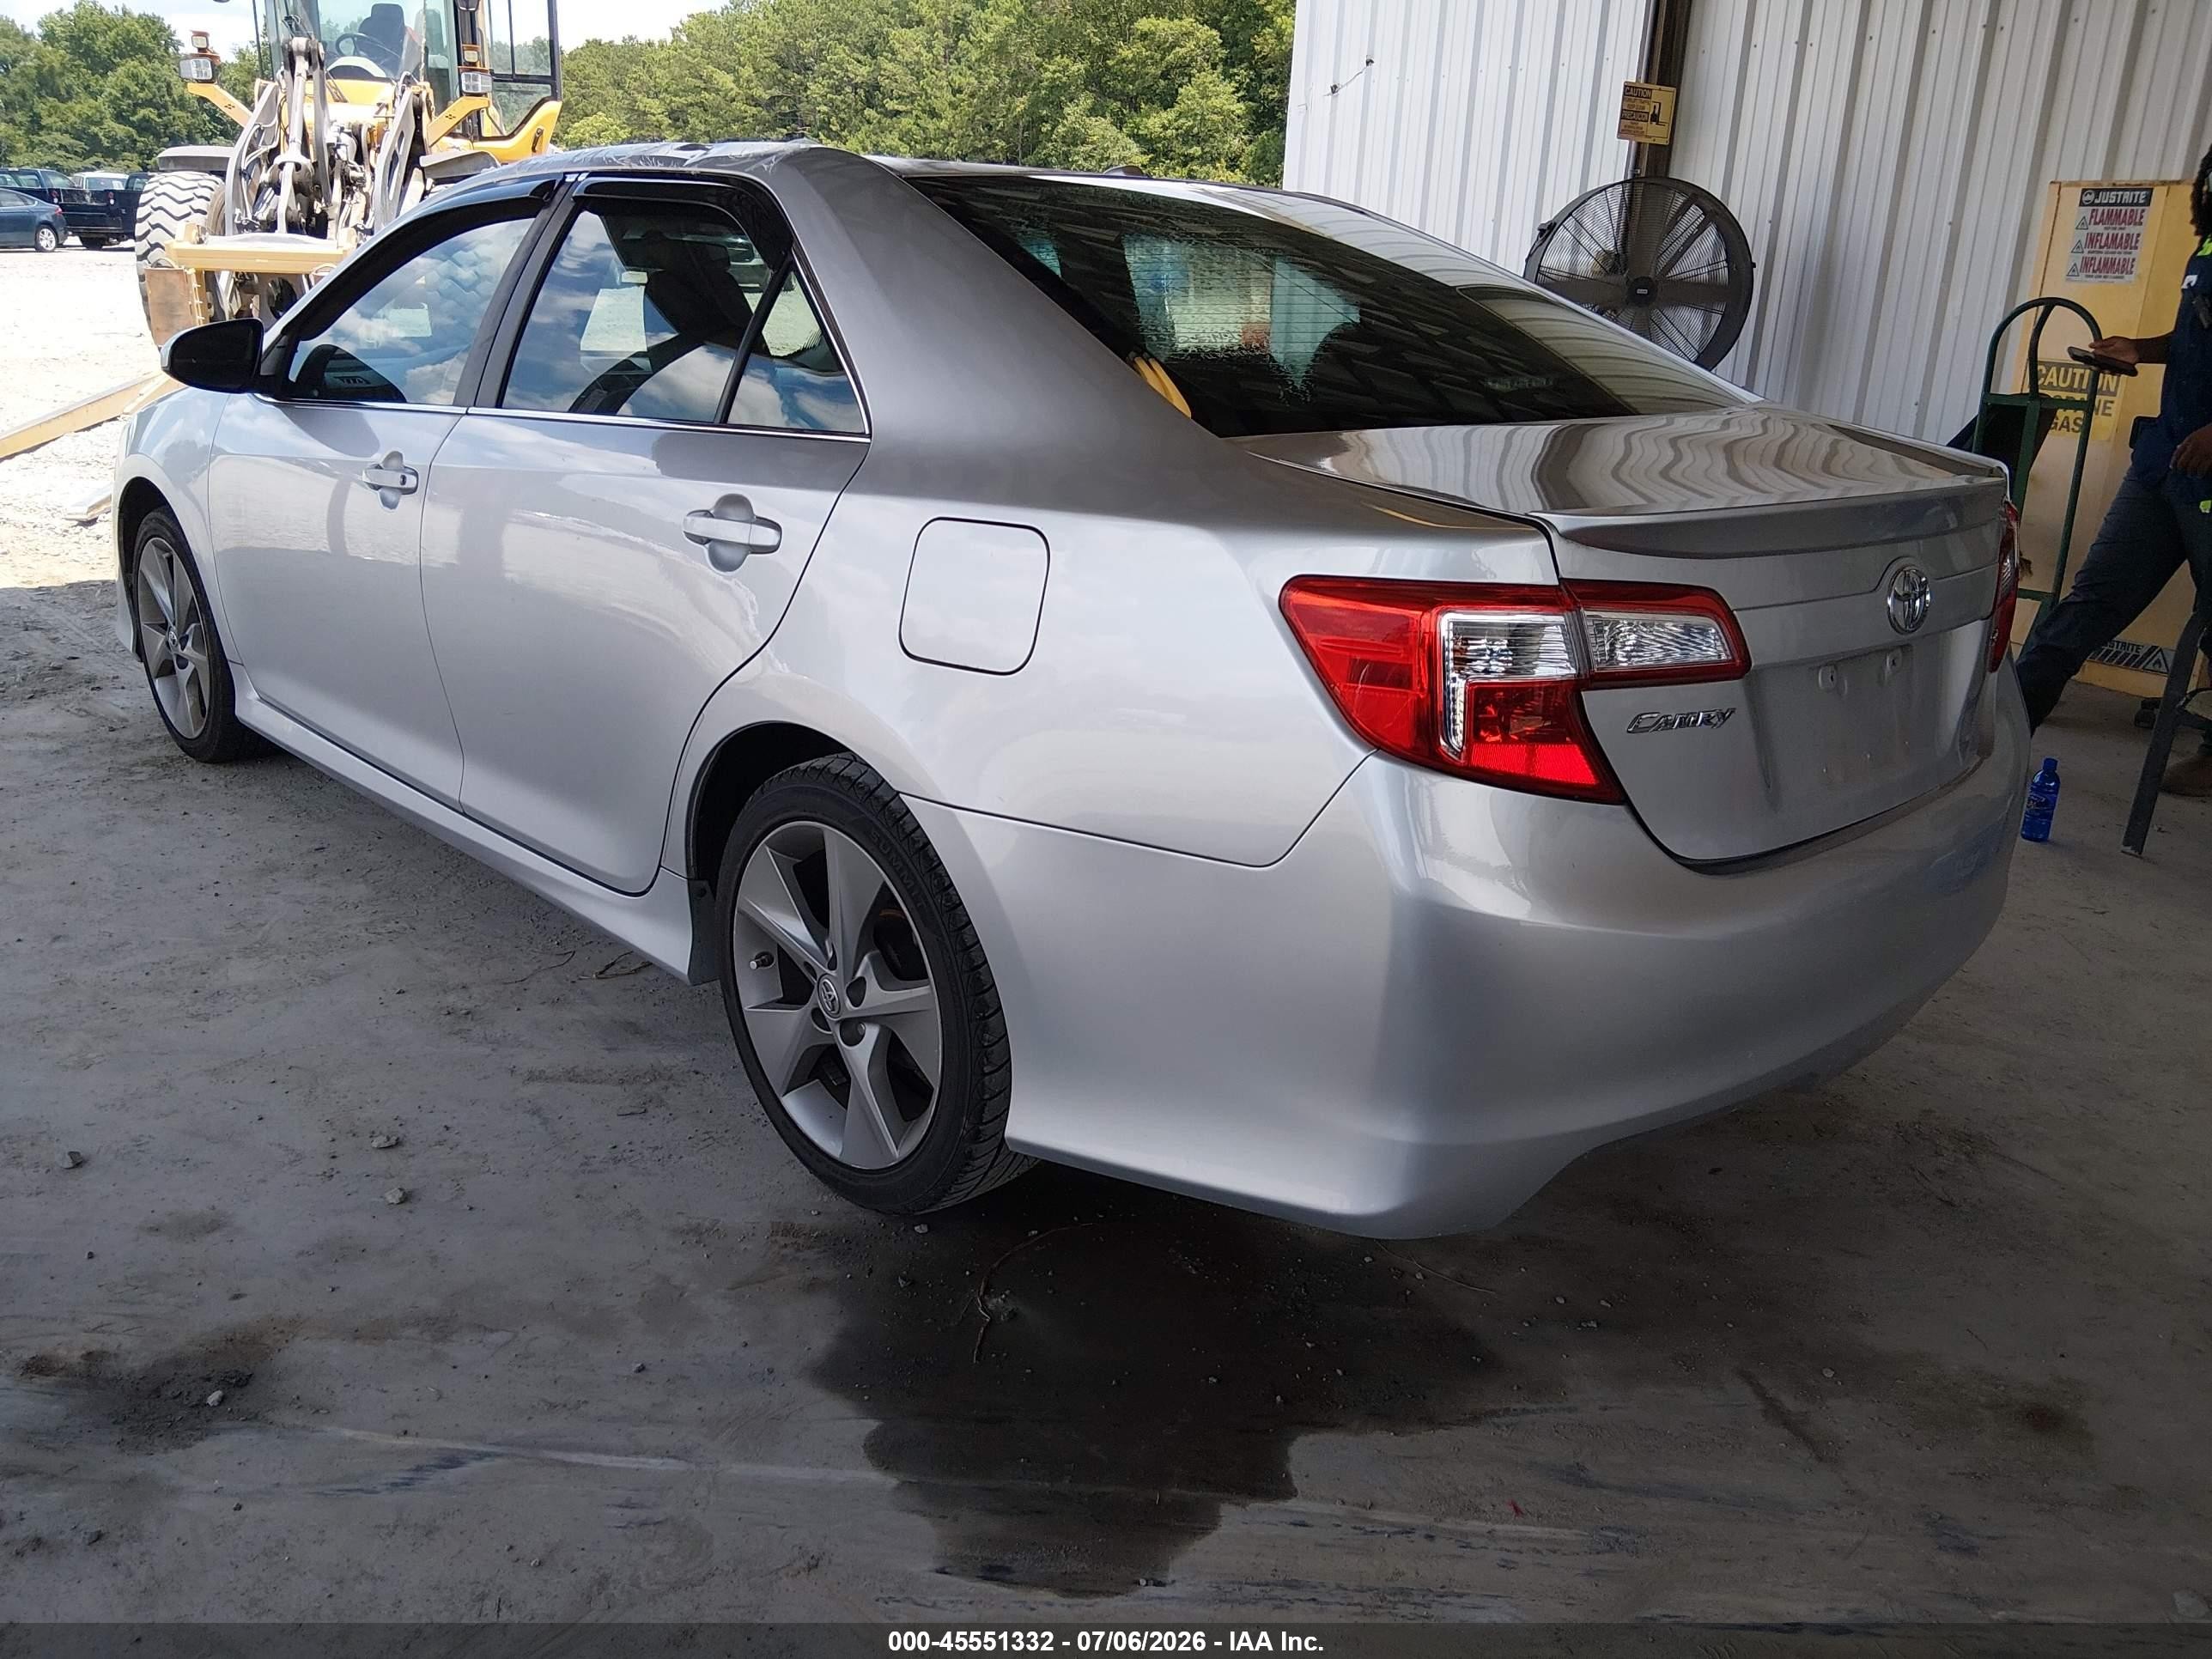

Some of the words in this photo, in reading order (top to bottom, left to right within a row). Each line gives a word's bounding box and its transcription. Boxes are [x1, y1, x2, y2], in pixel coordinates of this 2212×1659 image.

[1625, 87, 1651, 98] CAUTION
[2094, 191, 2148, 204] JUSTRITE
[2089, 209, 2145, 226] FLAMMABLE
[2084, 233, 2141, 251] INFLAMABLE
[2080, 257, 2136, 275] INFLAMMABLE
[2038, 365, 2117, 392] CAUTIN
